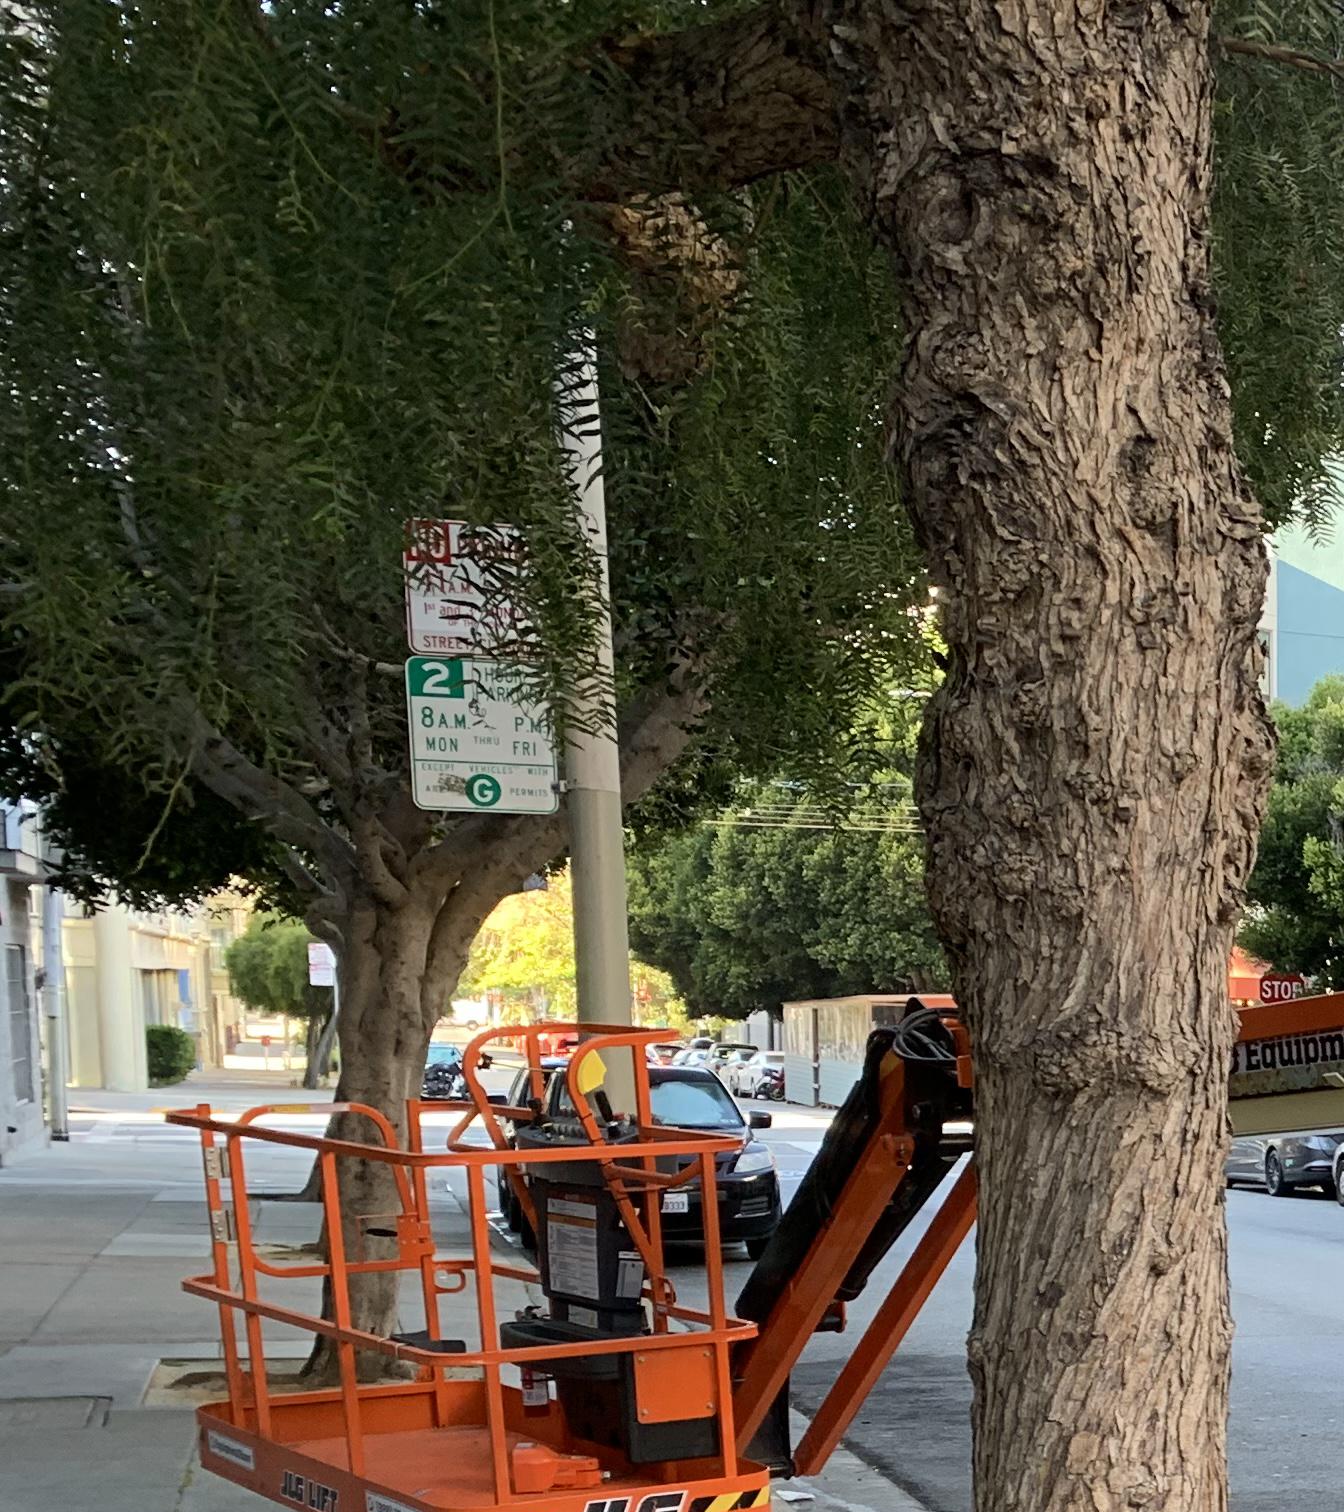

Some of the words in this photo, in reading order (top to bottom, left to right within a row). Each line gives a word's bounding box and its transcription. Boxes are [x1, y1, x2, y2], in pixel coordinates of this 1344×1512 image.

[421, 661, 451, 695] 2
[425, 736, 459, 753] MON
[474, 735, 500, 747] THRU
[512, 741, 537, 757] FRI
[421, 763, 455, 772] EXCEPT
[469, 765, 513, 775] VEHICLES
[527, 768, 549, 776] WITH
[473, 778, 494, 803] G
[509, 788, 549, 798] PERMITS
[280, 1470, 304, 1504] JLG
